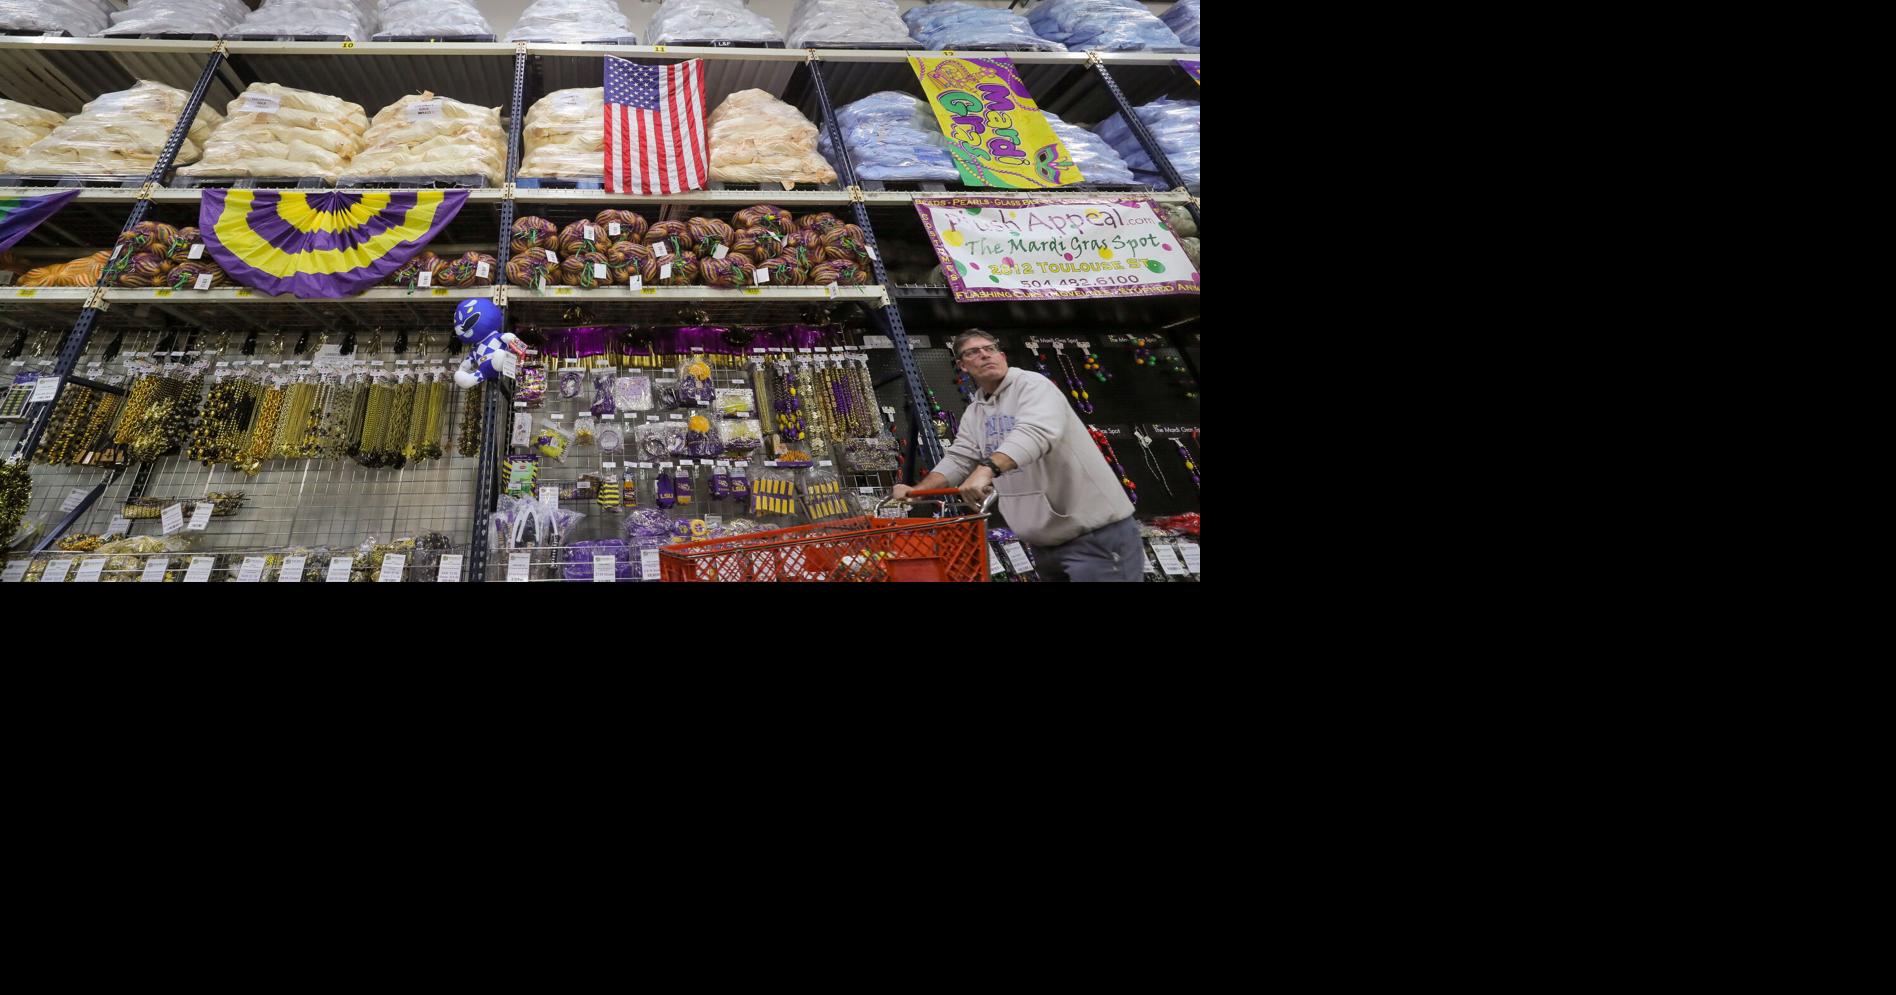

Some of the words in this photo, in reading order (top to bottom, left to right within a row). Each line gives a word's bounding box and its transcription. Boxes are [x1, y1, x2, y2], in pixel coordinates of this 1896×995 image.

[936, 89, 991, 161] Gras
[975, 83, 1031, 166] Mardi
[952, 198, 990, 206] PEARLS
[965, 237, 1004, 255] The
[1008, 236, 1067, 257] Mardi
[1071, 235, 1108, 259] Gras
[1112, 233, 1160, 258] Spot
[988, 262, 1034, 276] 2012
[1036, 260, 1125, 274] TOULOUSE
